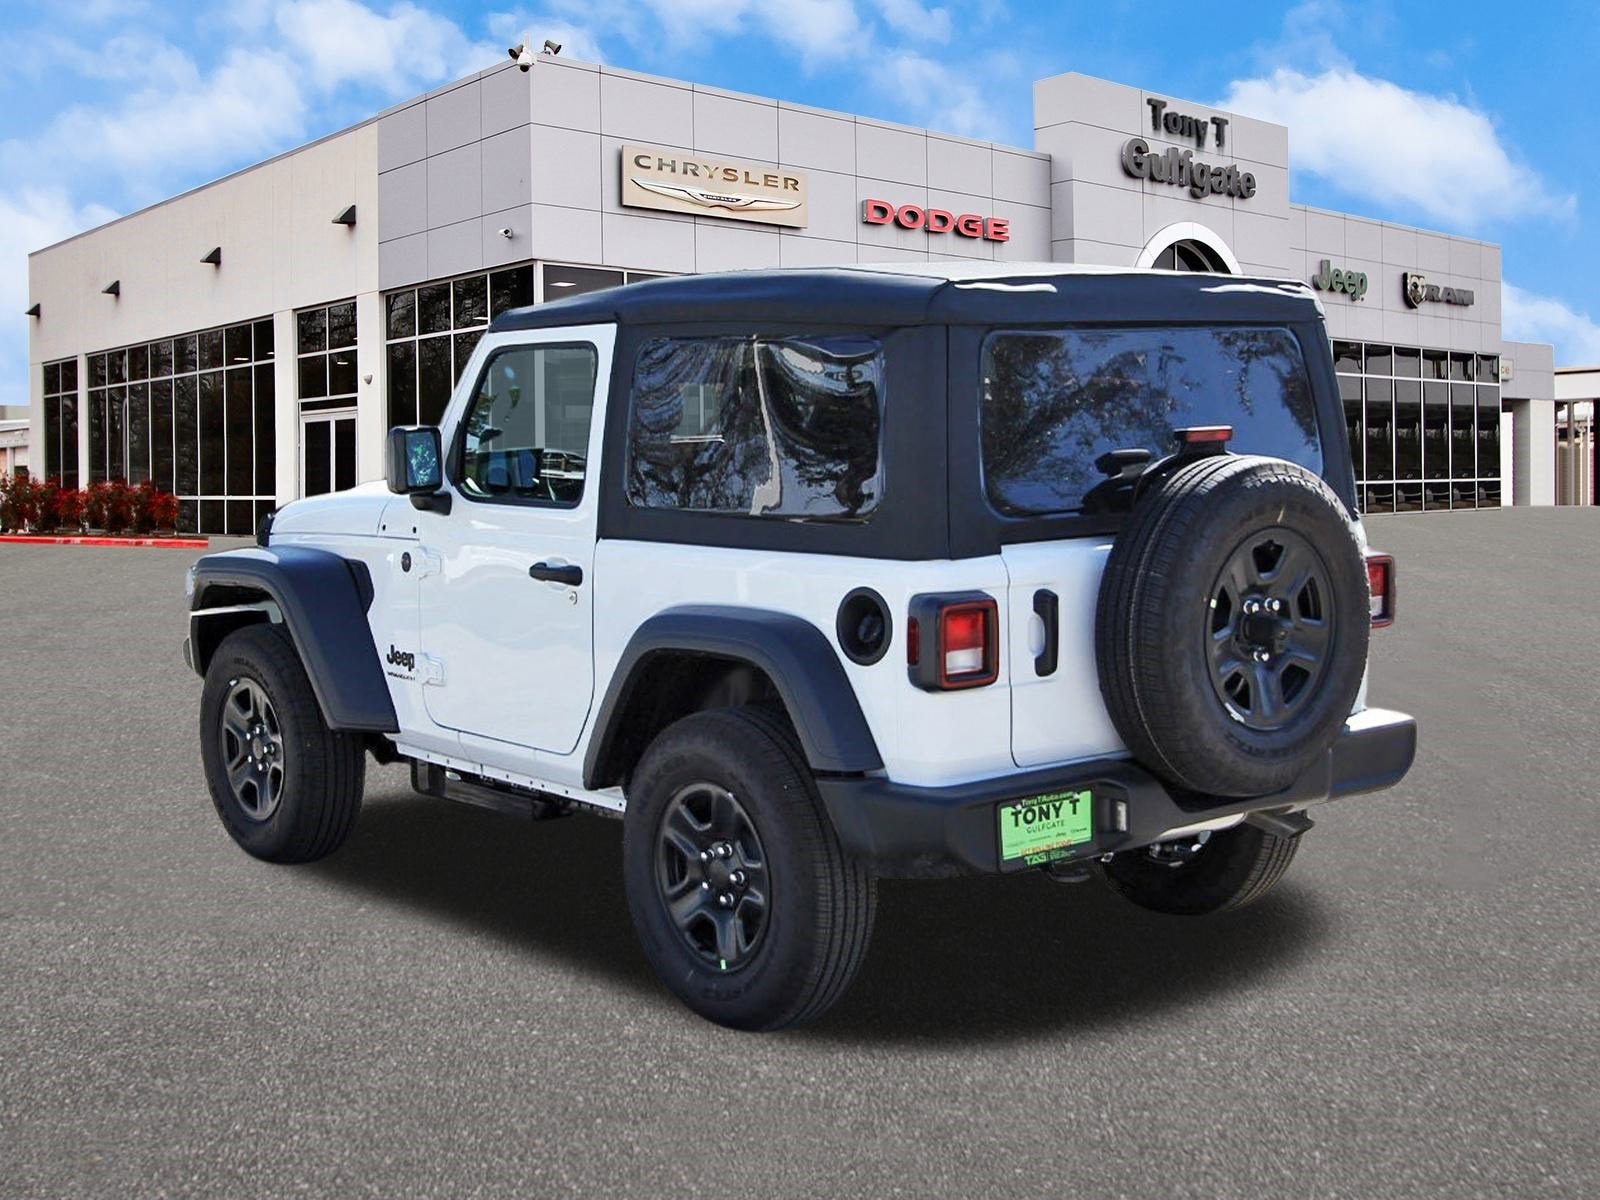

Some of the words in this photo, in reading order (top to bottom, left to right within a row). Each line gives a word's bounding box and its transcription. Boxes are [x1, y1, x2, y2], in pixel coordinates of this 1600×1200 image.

[1146, 97, 1209, 149] Tony
[1210, 116, 1230, 148] T
[633, 154, 801, 192] CHRYSLER
[1120, 138, 1257, 200] Gulfgate
[862, 198, 1010, 242] DODGE
[1313, 259, 1369, 301] Jeep
[1425, 284, 1475, 307] RAM
[386, 644, 415, 672] Jeep
[1011, 801, 1063, 827] TONY
[1069, 798, 1081, 815] T
[1027, 820, 1065, 833] GULFGATE
